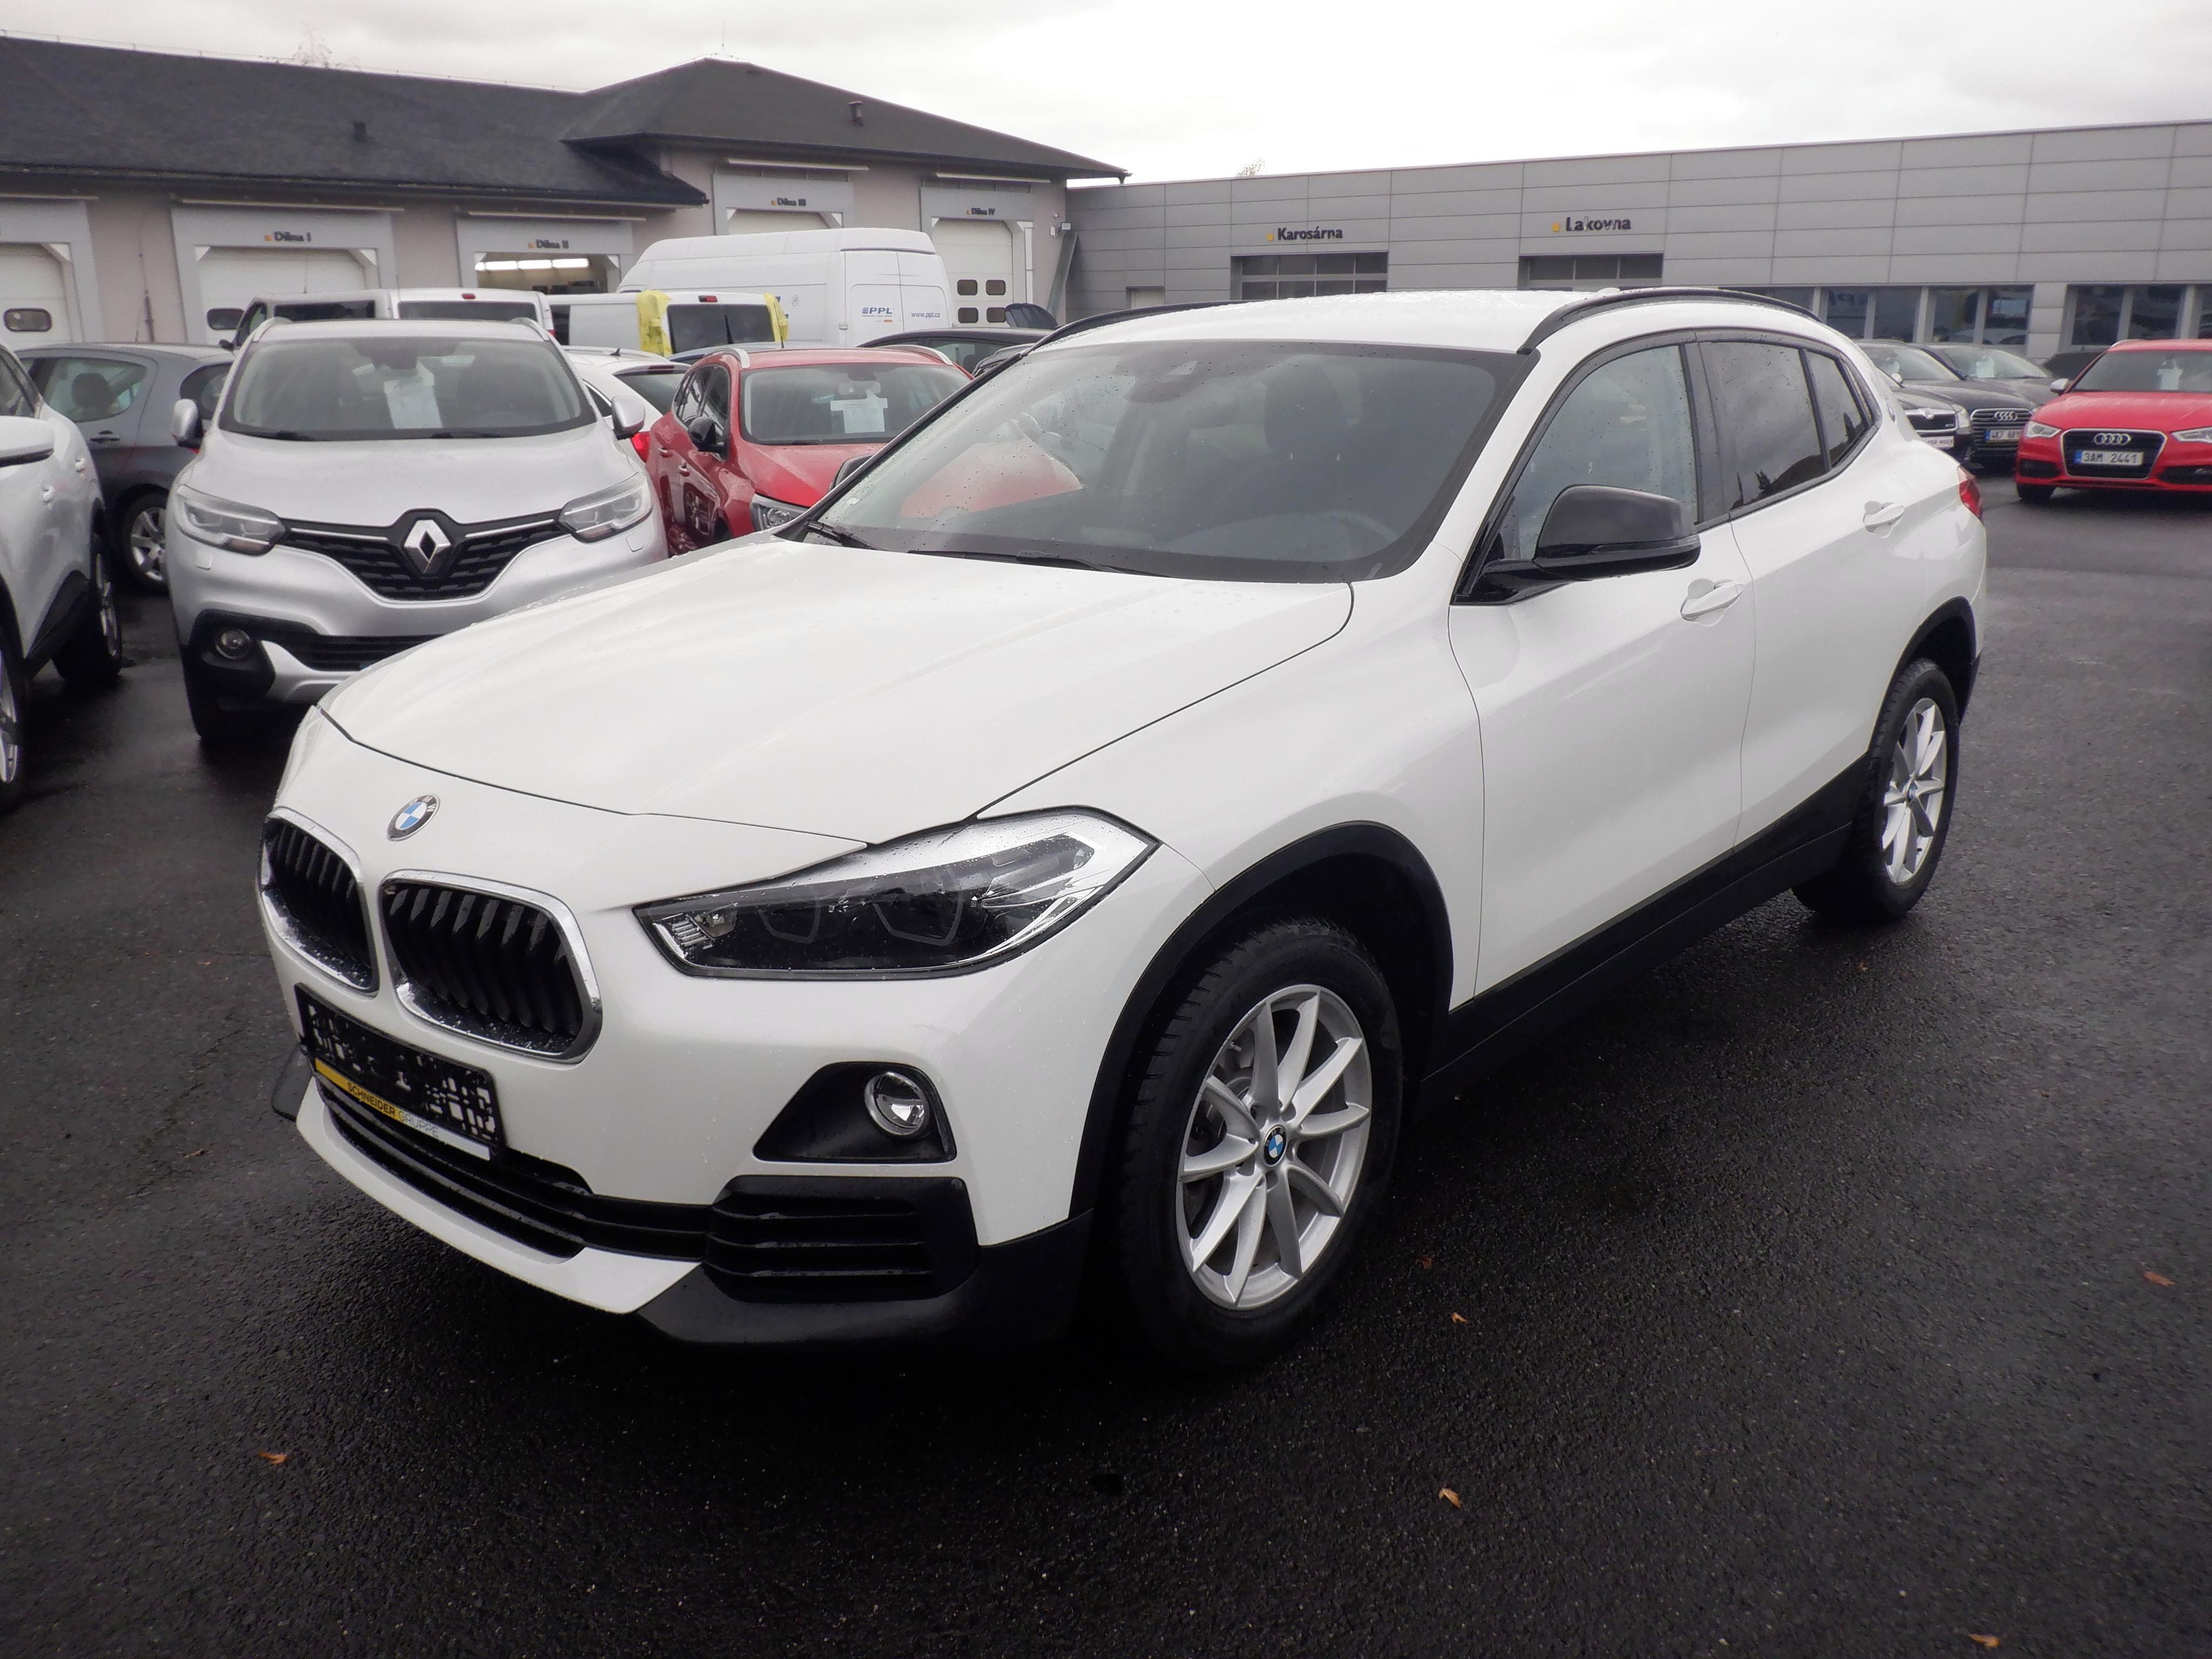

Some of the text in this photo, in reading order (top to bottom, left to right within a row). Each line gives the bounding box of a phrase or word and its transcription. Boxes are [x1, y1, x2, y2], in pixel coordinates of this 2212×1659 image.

[1278, 226, 1343, 240] Karosárna
[2084, 452, 2103, 463] 3AM
[346, 1081, 439, 1138] SCHNEIDER GRUPPE
